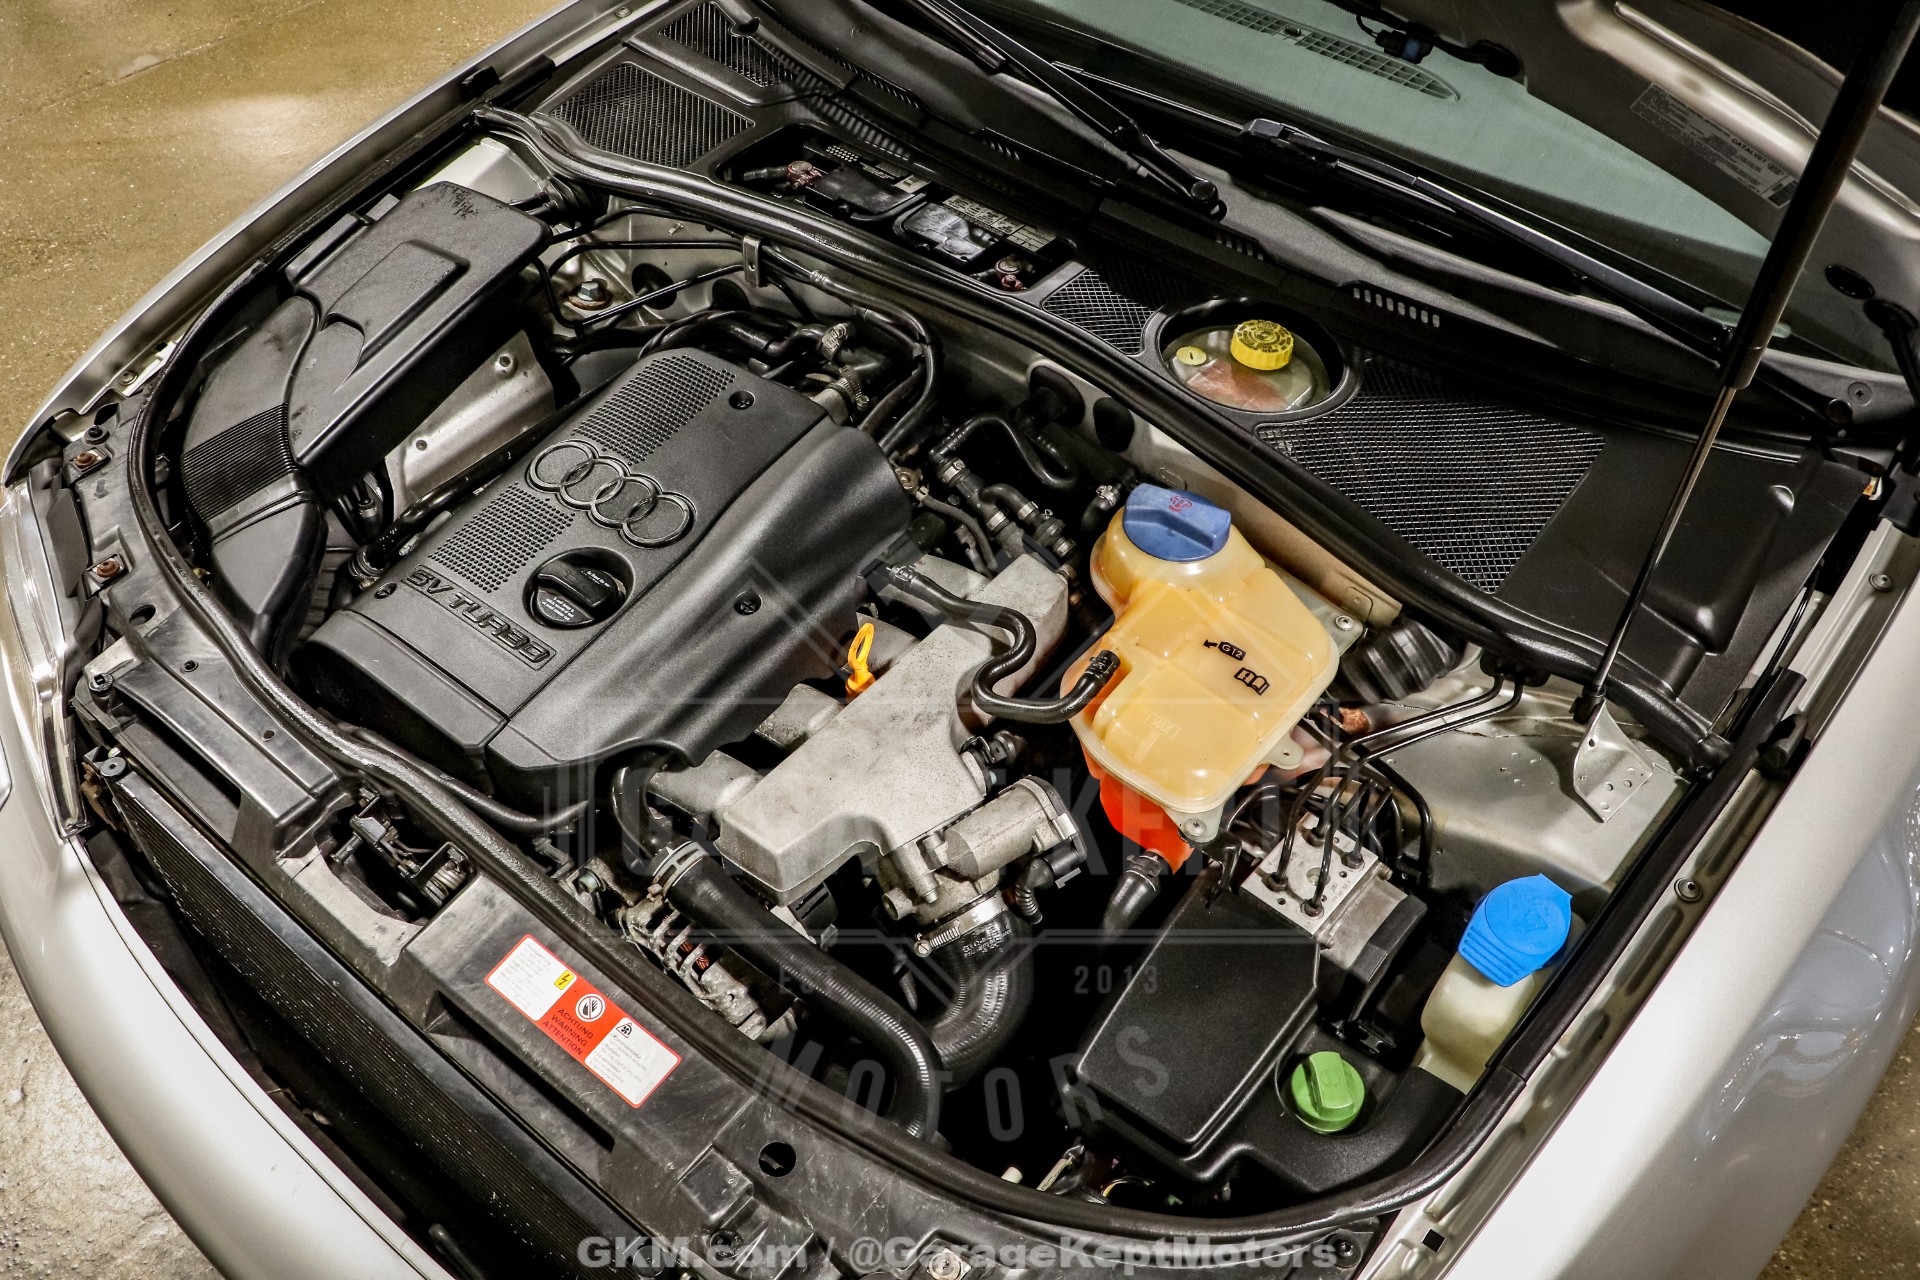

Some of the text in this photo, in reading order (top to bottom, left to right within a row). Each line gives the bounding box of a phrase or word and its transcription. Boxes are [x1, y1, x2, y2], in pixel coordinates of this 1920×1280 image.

[1731, 138, 1768, 164] CATALYST
[449, 591, 551, 664] TURBO
[1222, 644, 1243, 659] G12
[542, 1021, 584, 1055] ATTENTION
[551, 1014, 588, 1047] WARNING
[557, 1009, 594, 1039] ACHTUNG
